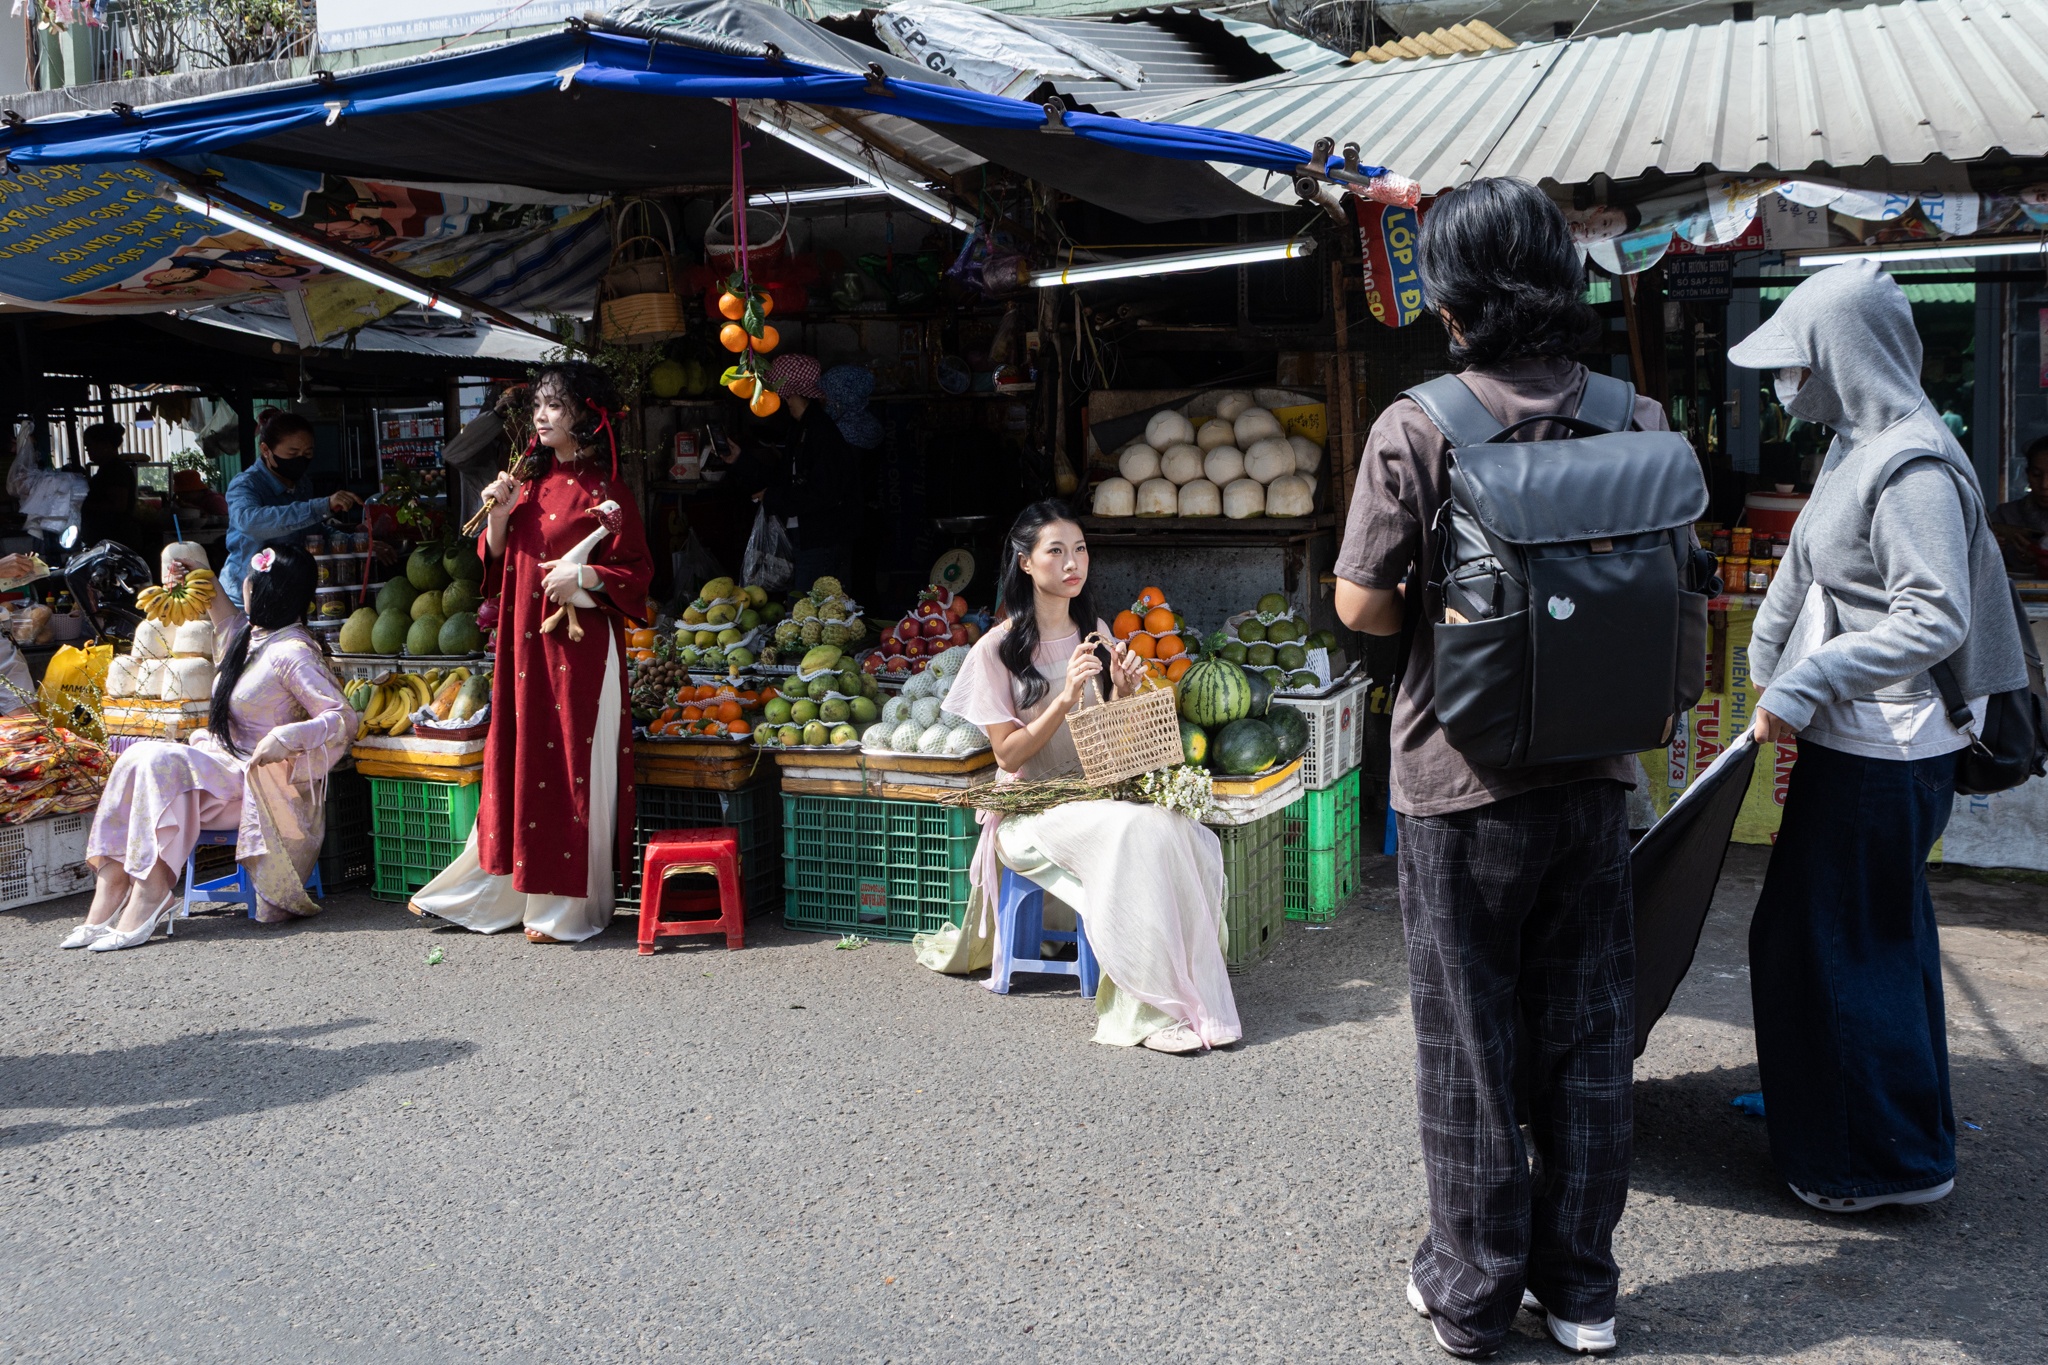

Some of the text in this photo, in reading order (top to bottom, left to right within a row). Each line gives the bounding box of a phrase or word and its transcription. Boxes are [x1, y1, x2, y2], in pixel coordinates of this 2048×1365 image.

[1387, 212, 1416, 265] LỚP
[60, 263, 116, 285] MẠNH
[1398, 269, 1418, 284] 1
[1731, 692, 1748, 719] PHÍ
[1670, 739, 1687, 780] 31/3
